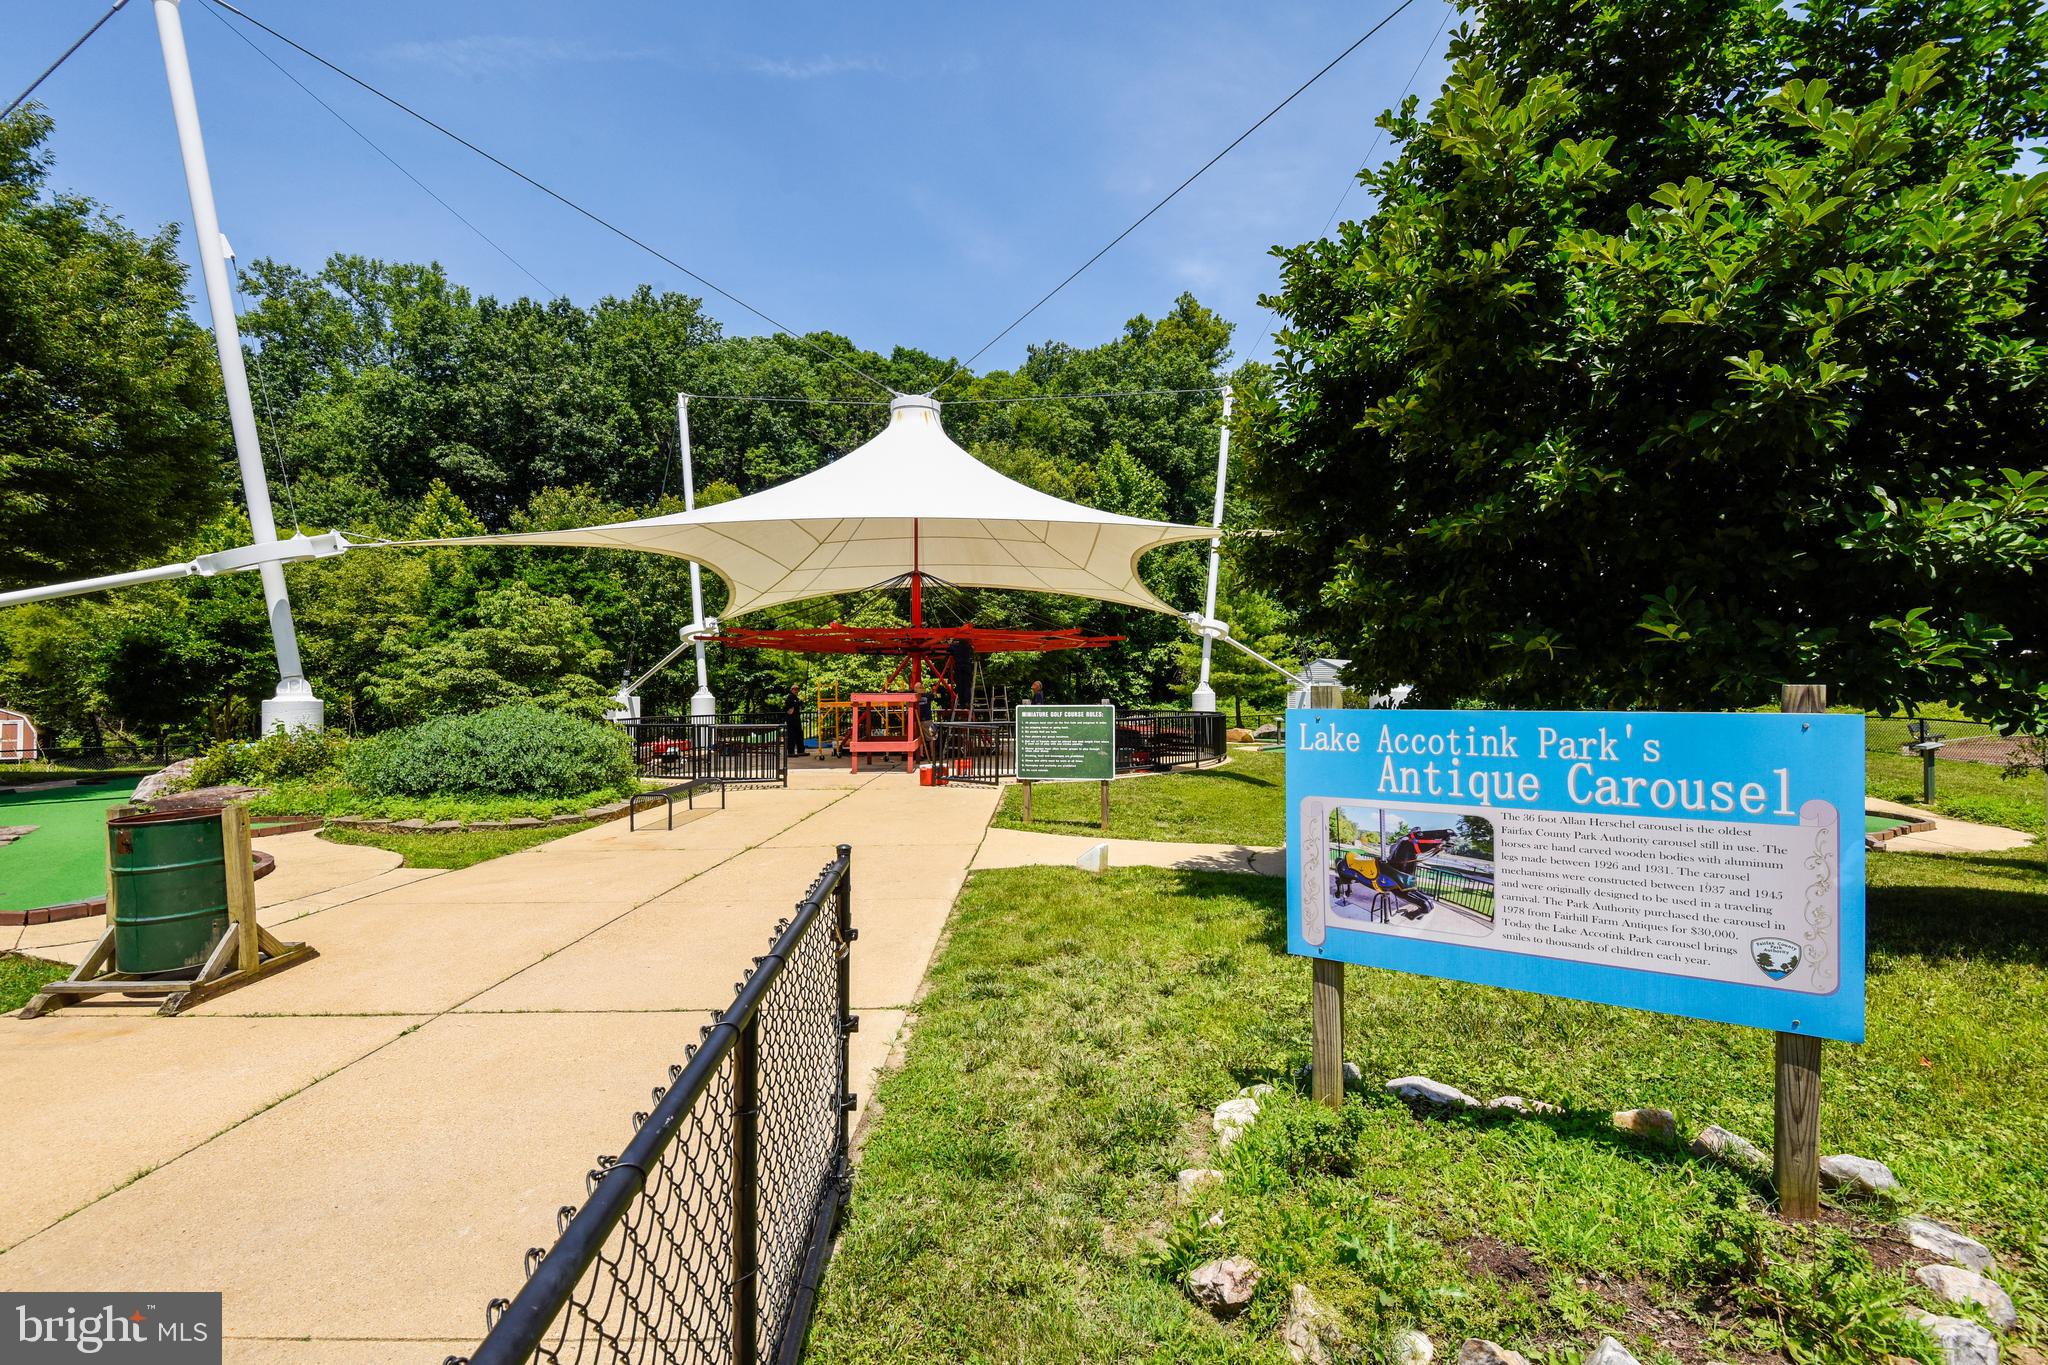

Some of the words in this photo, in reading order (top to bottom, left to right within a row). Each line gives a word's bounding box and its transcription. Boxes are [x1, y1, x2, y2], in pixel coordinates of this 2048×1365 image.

[1299, 722, 1360, 752] Lake
[1377, 724, 1518, 758] Accotink
[1538, 723, 1661, 762] Park's
[1377, 755, 1539, 806] Antique
[1567, 762, 1796, 817] Carousel
[1500, 811, 1520, 822] The
[1522, 813, 1535, 822] 36
[1537, 814, 1557, 824] foot
[1559, 816, 1586, 826] Allan
[1589, 817, 1635, 829] Herschel
[1638, 823, 1682, 832] carousel
[1685, 823, 1694, 833] is
[1697, 824, 1714, 834] the
[1717, 826, 1752, 837] oldest
[1501, 825, 1533, 836] Fairfax
[1535, 828, 1571, 840] County
[1574, 830, 1597, 841] Park
[1599, 832, 1648, 847] Authority
[1651, 839, 1697, 848] carousel
[1700, 840, 1719, 850] still
[1722, 841, 1733, 851] in
[1736, 845, 1759, 853] use.
[1762, 844, 1788, 855] The
[1500, 838, 1531, 849] horses
[1551, 842, 1576, 853] hand
[1578, 846, 1612, 856] carved
[1614, 849, 1656, 859] wooden
[1658, 850, 1695, 862] bodies
[1697, 855, 1721, 865] with
[1724, 856, 1784, 870] aluminum
[1501, 851, 1519, 862] legs
[1520, 854, 1547, 864] made
[1550, 855, 1590, 868] between
[1594, 859, 1619, 870] 1926
[1621, 863, 1641, 872] and
[1645, 864, 1674, 875] 1931.
[1676, 866, 1700, 877] The
[1703, 871, 1750, 882] carousel
[1500, 879, 1519, 888] and
[1520, 883, 1544, 891] were
[1546, 883, 1592, 896] originally
[1593, 888, 1639, 901] designed
[1641, 894, 1653, 902] to
[1655, 893, 1669, 904] be
[1671, 897, 1697, 907] used
[1700, 898, 1711, 908] in
[1723, 902, 1773, 916] traveling
[1501, 866, 1560, 879] mechanisms
[1561, 873, 1586, 882] were
[1587, 876, 1647, 888] constructed
[1650, 879, 1695, 892] between
[1699, 884, 1726, 894] 1937
[1729, 887, 1750, 897] and
[1755, 888, 1783, 900] 1945
[1501, 894, 1540, 904] carnival.
[1542, 896, 1563, 906] The
[1566, 898, 1589, 909] Park
[1592, 901, 1640, 916] Authority
[1644, 909, 1699, 921] purchased
[1702, 913, 1720, 923] the
[1723, 918, 1770, 929] carousel
[1774, 920, 1786, 931] in
[1503, 905, 1525, 915] 1978
[1527, 908, 1551, 919] from
[1554, 910, 1588, 923] Fairhill
[1591, 914, 1619, 926] Farm
[1621, 918, 1669, 932] Antiques
[1671, 924, 1686, 934] for
[1690, 926, 1739, 940] $30,000.
[1501, 917, 1531, 931] Today
[1534, 921, 1550, 931] the
[1552, 923, 1577, 935] Lake
[1579, 928, 1625, 941] Accotink
[1628, 932, 1653, 944] Park
[1655, 939, 1700, 950] carousel
[1703, 941, 1738, 956] brings
[1501, 932, 1531, 942] smiles
[1545, 936, 1595, 950] thousands
[1597, 944, 1610, 953] of
[1610, 945, 1654, 959] children
[1656, 952, 1681, 962] each
[1684, 956, 1712, 966] year.
